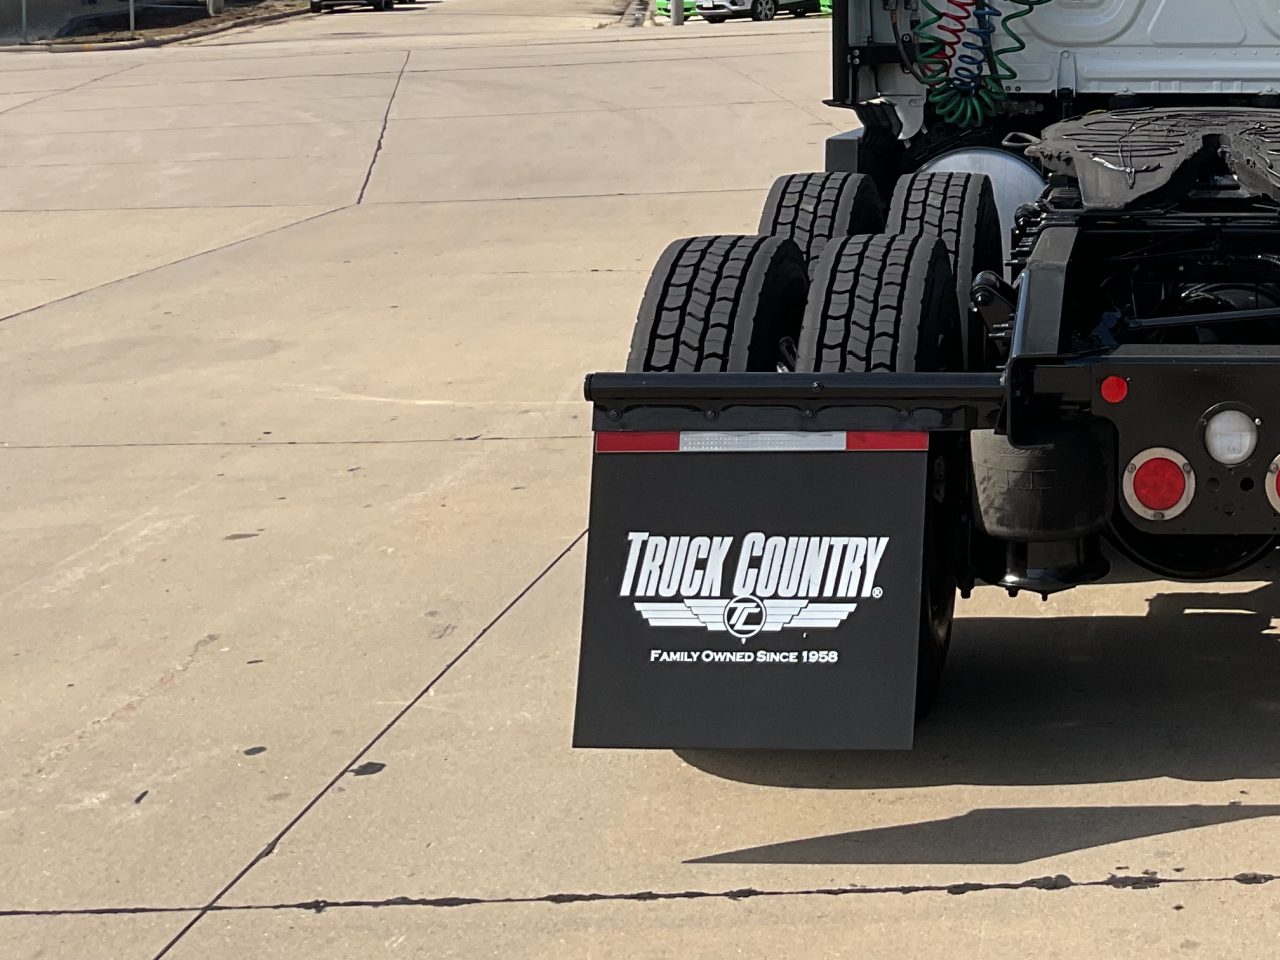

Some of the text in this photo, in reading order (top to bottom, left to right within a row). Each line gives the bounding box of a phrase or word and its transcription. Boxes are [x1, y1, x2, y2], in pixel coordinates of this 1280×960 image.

[619, 532, 733, 597] TRUCK
[649, 649, 839, 664] FAMILY OWNED SINCE 1958
